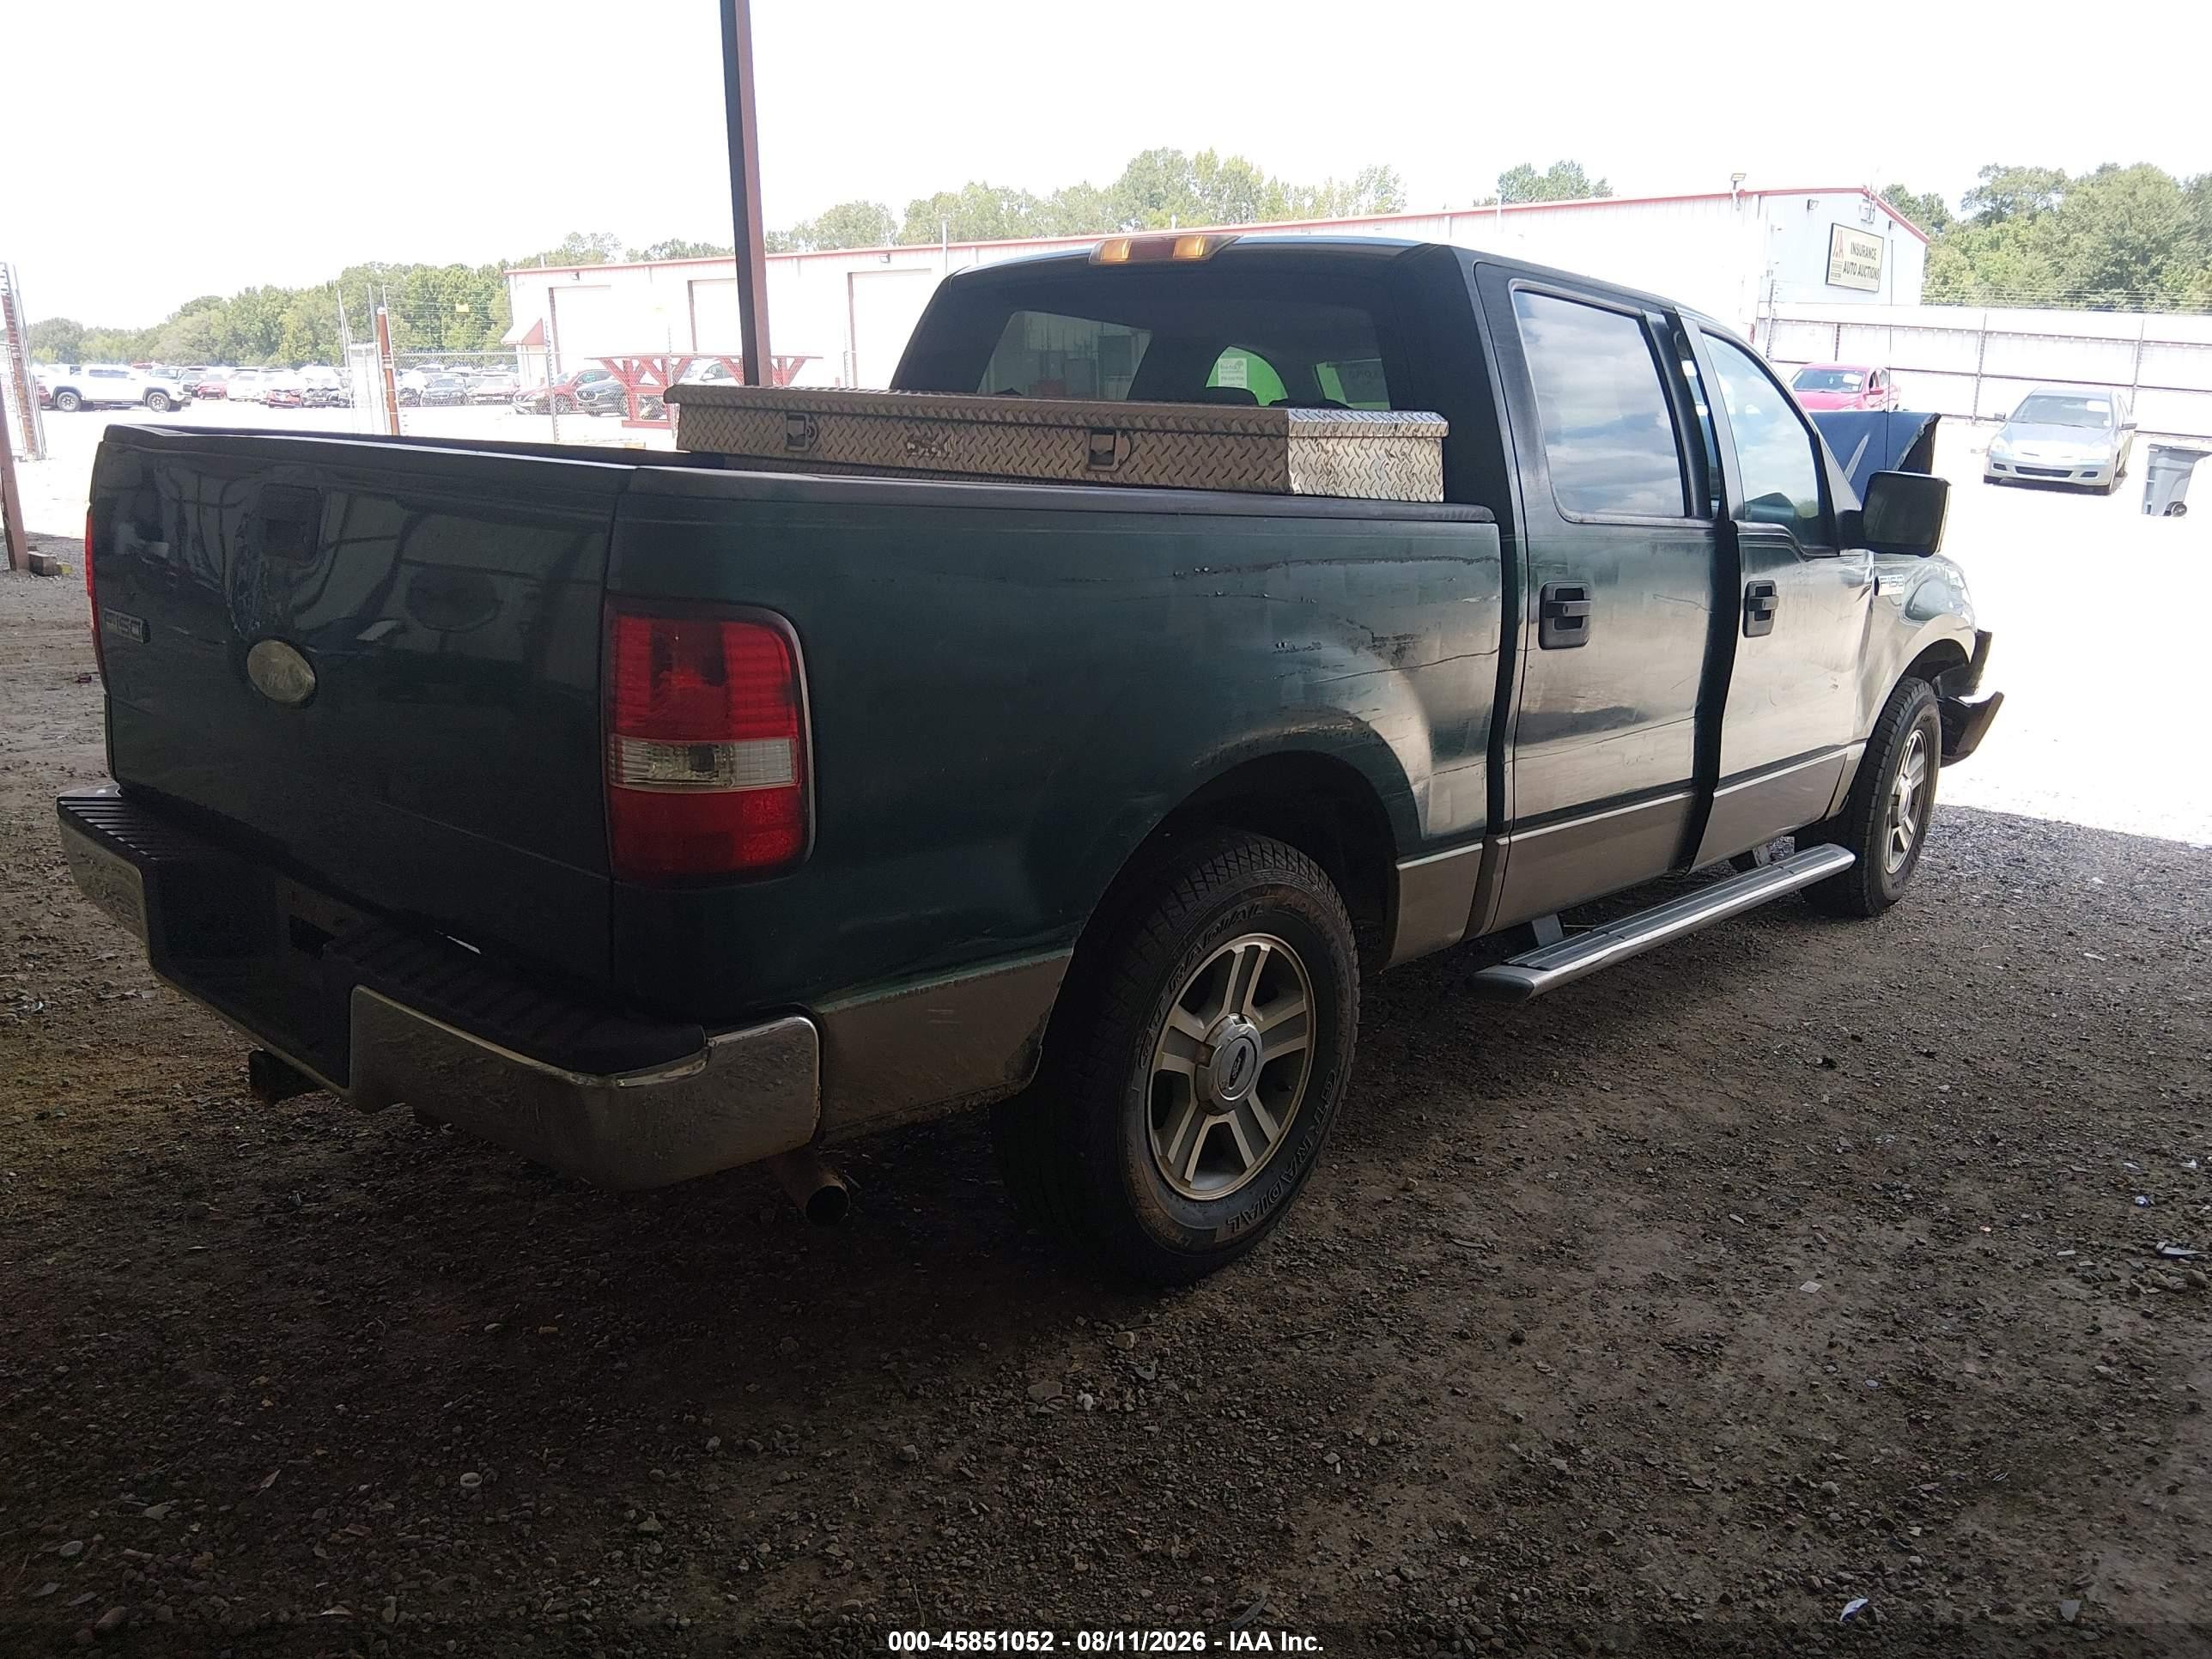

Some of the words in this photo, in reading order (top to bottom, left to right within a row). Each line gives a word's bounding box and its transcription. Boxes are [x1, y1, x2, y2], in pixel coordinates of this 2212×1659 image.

[1850, 241, 1877, 261] INSURANCE
[1843, 261, 1857, 276] AUTO
[1857, 264, 1881, 282] AUCTIONS
[1226, 1134, 1314, 1234] RADIAL
